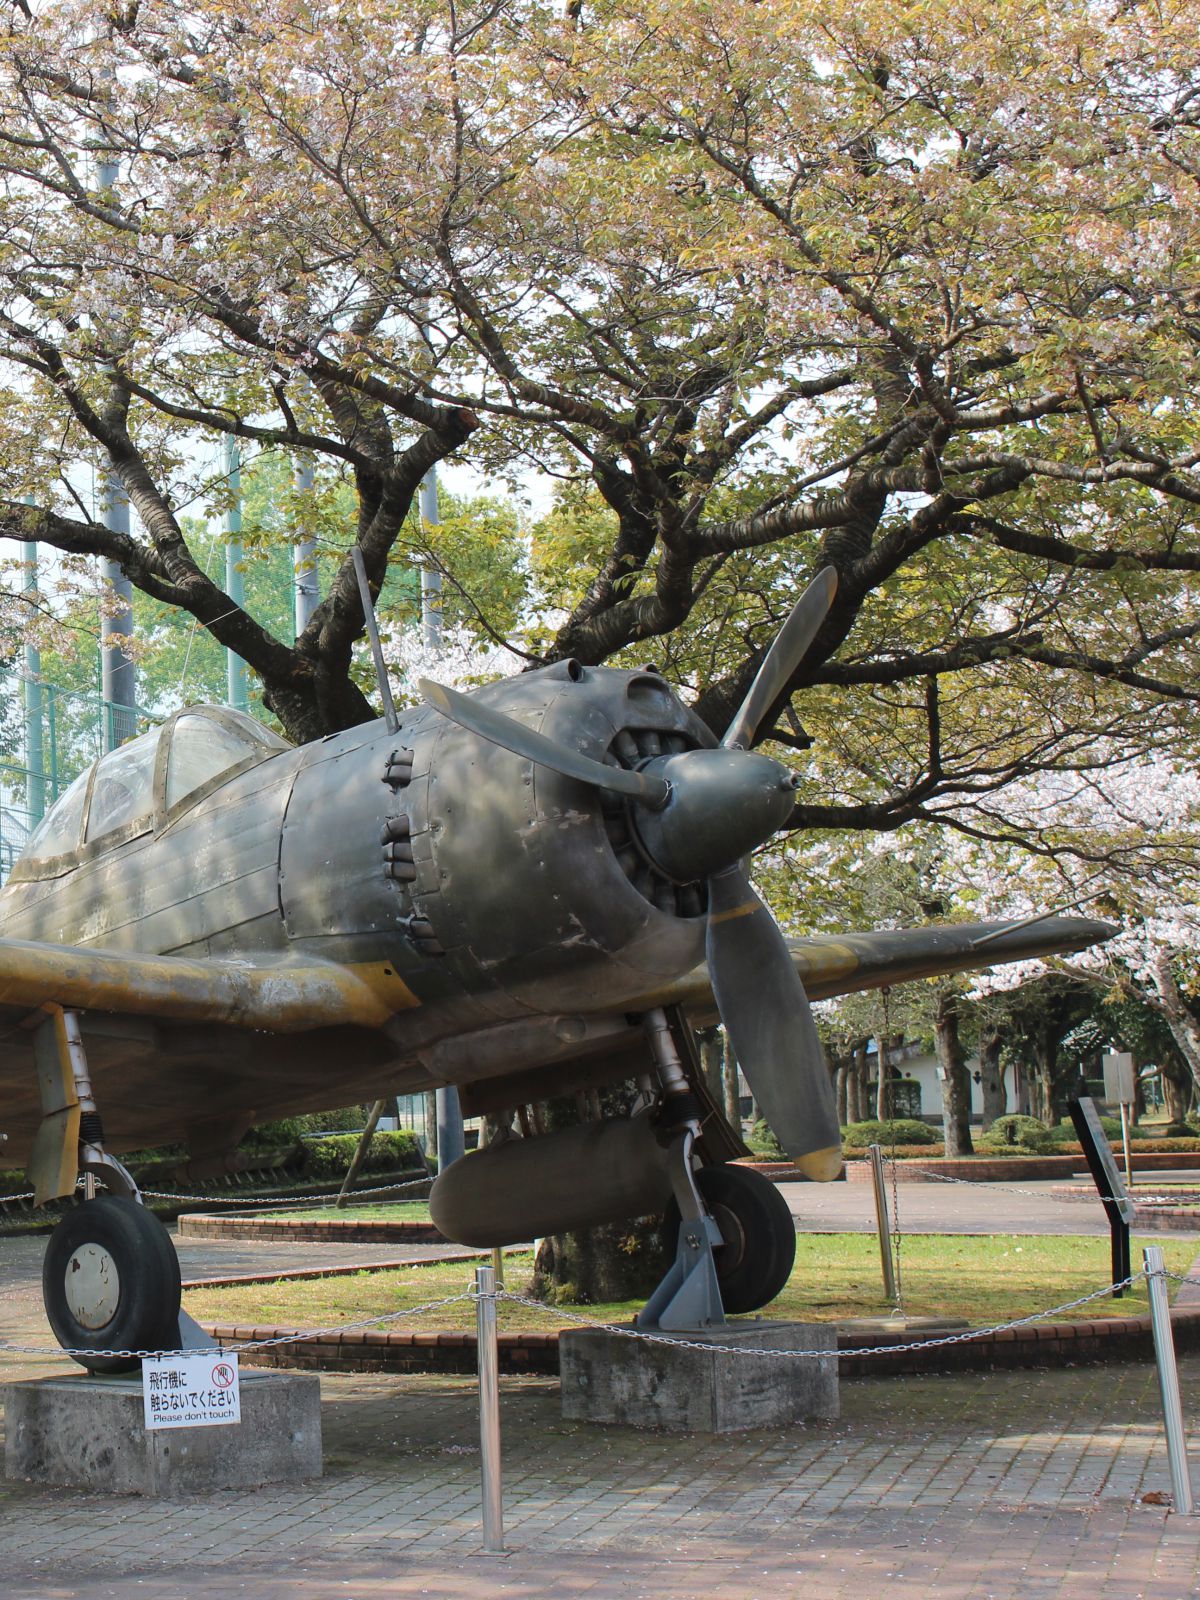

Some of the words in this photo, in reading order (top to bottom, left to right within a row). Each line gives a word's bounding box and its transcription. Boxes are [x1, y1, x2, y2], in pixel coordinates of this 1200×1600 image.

[149, 1370, 187, 1390] 飛行機に
[151, 1390, 236, 1412] 触らないでください
[153, 1414, 183, 1423] Please
[184, 1412, 207, 1421] don't
[209, 1409, 235, 1418] touch
